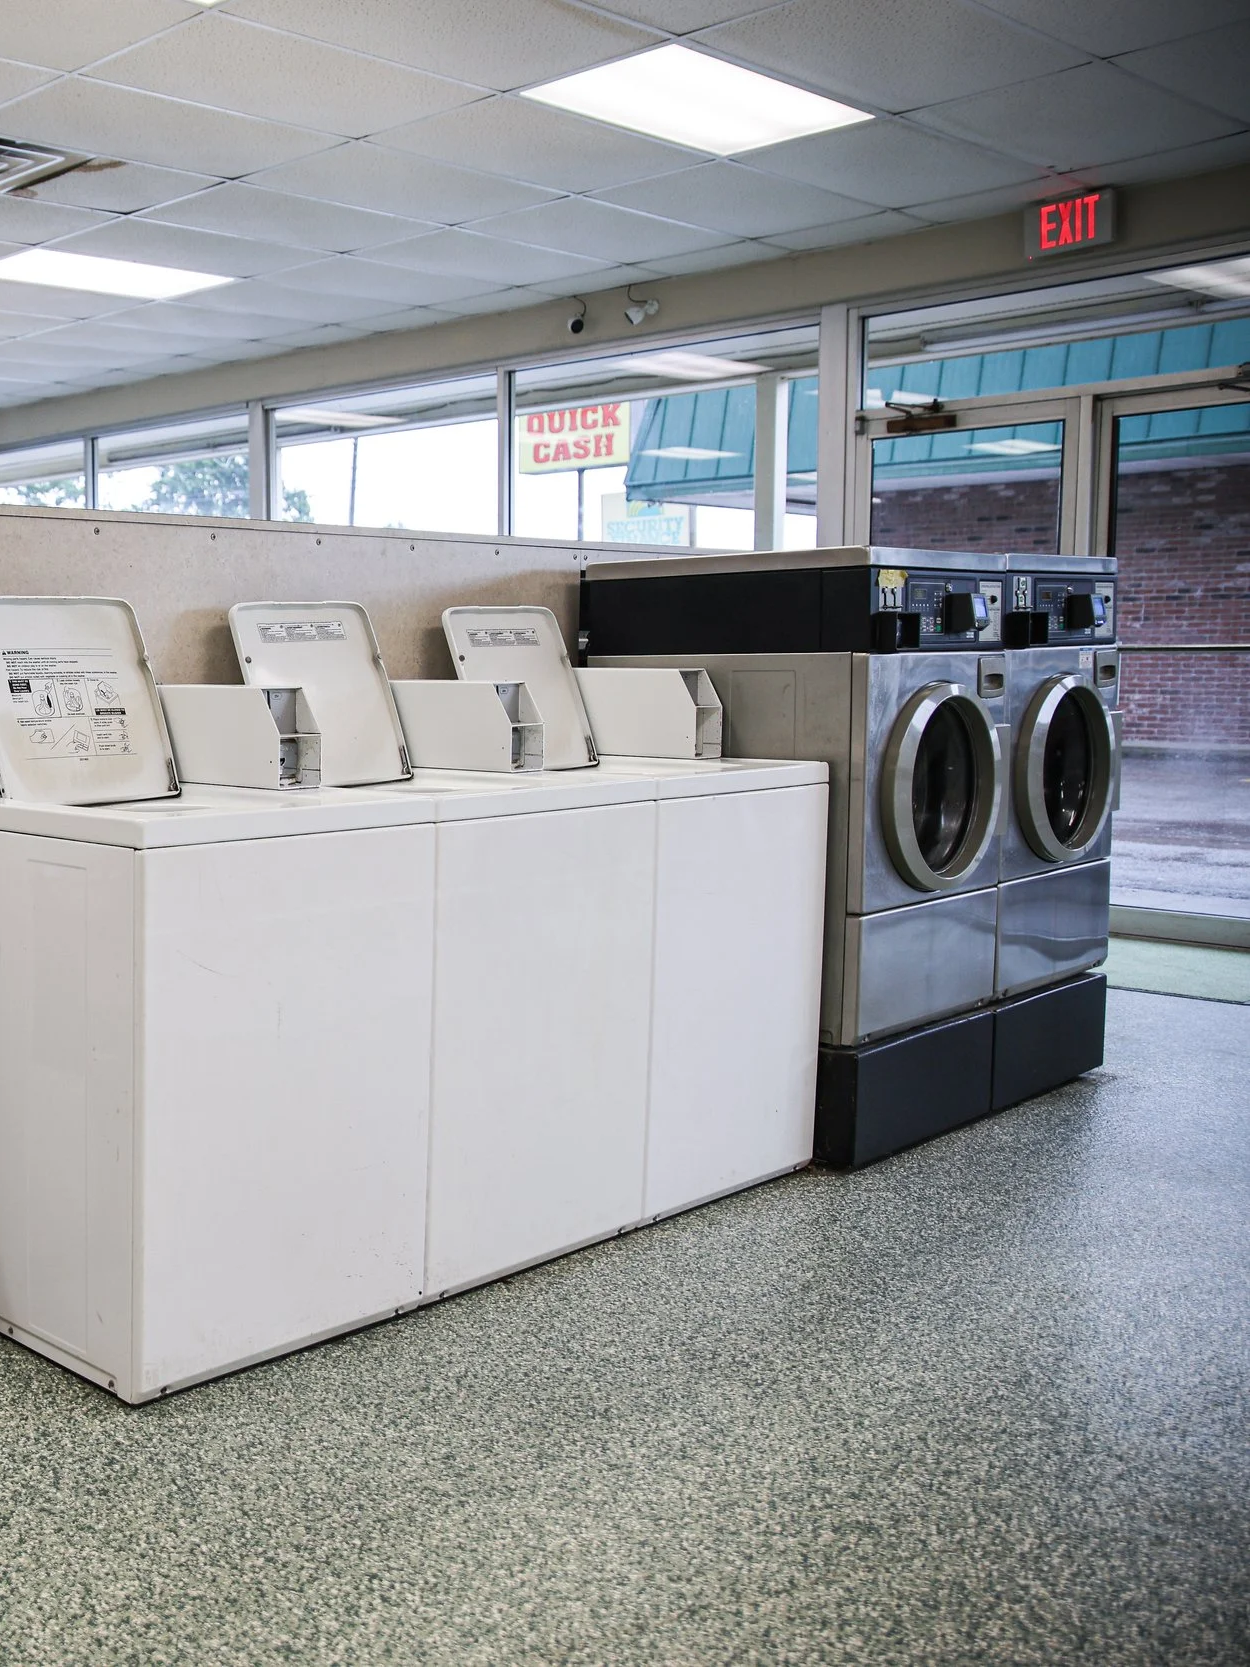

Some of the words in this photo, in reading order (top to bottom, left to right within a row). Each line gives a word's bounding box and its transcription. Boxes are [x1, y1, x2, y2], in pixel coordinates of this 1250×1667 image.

[1040, 194, 1100, 250] EXIT
[533, 433, 614, 463] CASH
[607, 516, 684, 535] SECURITY
